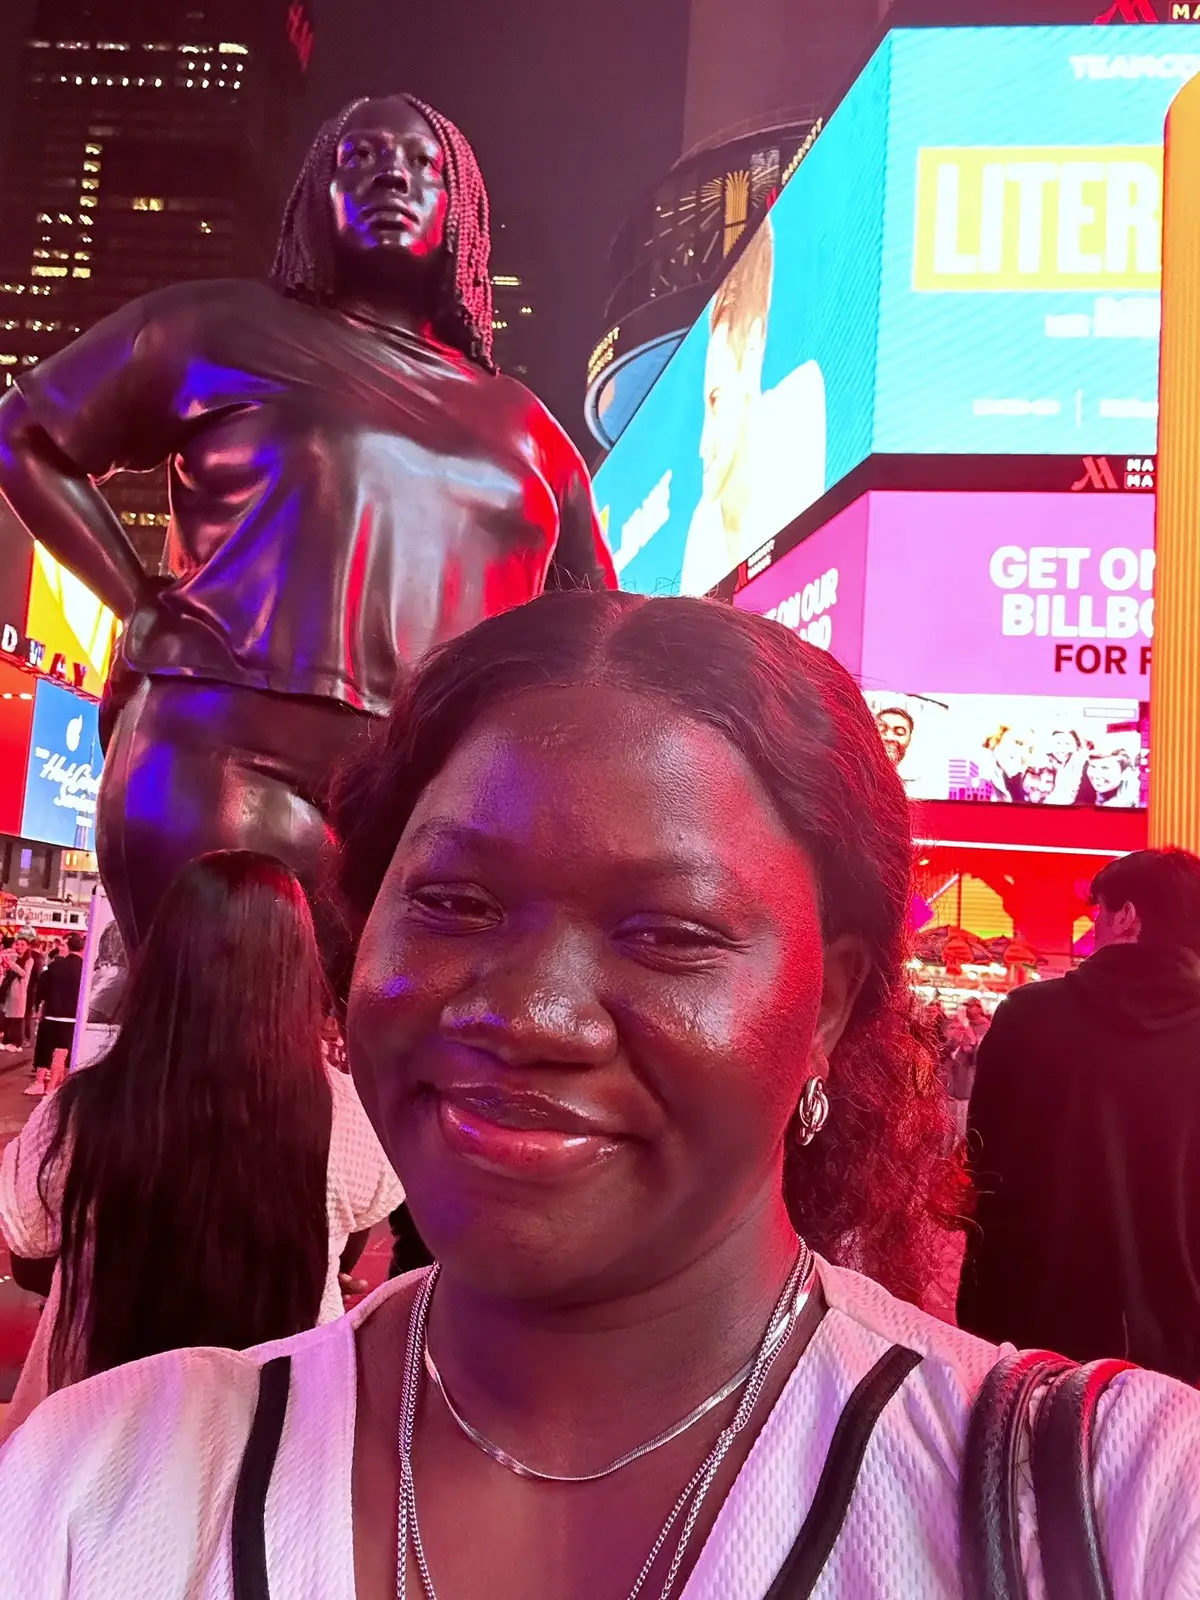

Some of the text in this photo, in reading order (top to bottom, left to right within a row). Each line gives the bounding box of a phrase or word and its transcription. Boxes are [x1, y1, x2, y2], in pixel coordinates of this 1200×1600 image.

[989, 545, 1091, 590] GET
[801, 568, 839, 622] OUR
[1054, 644, 1128, 675] FOR
